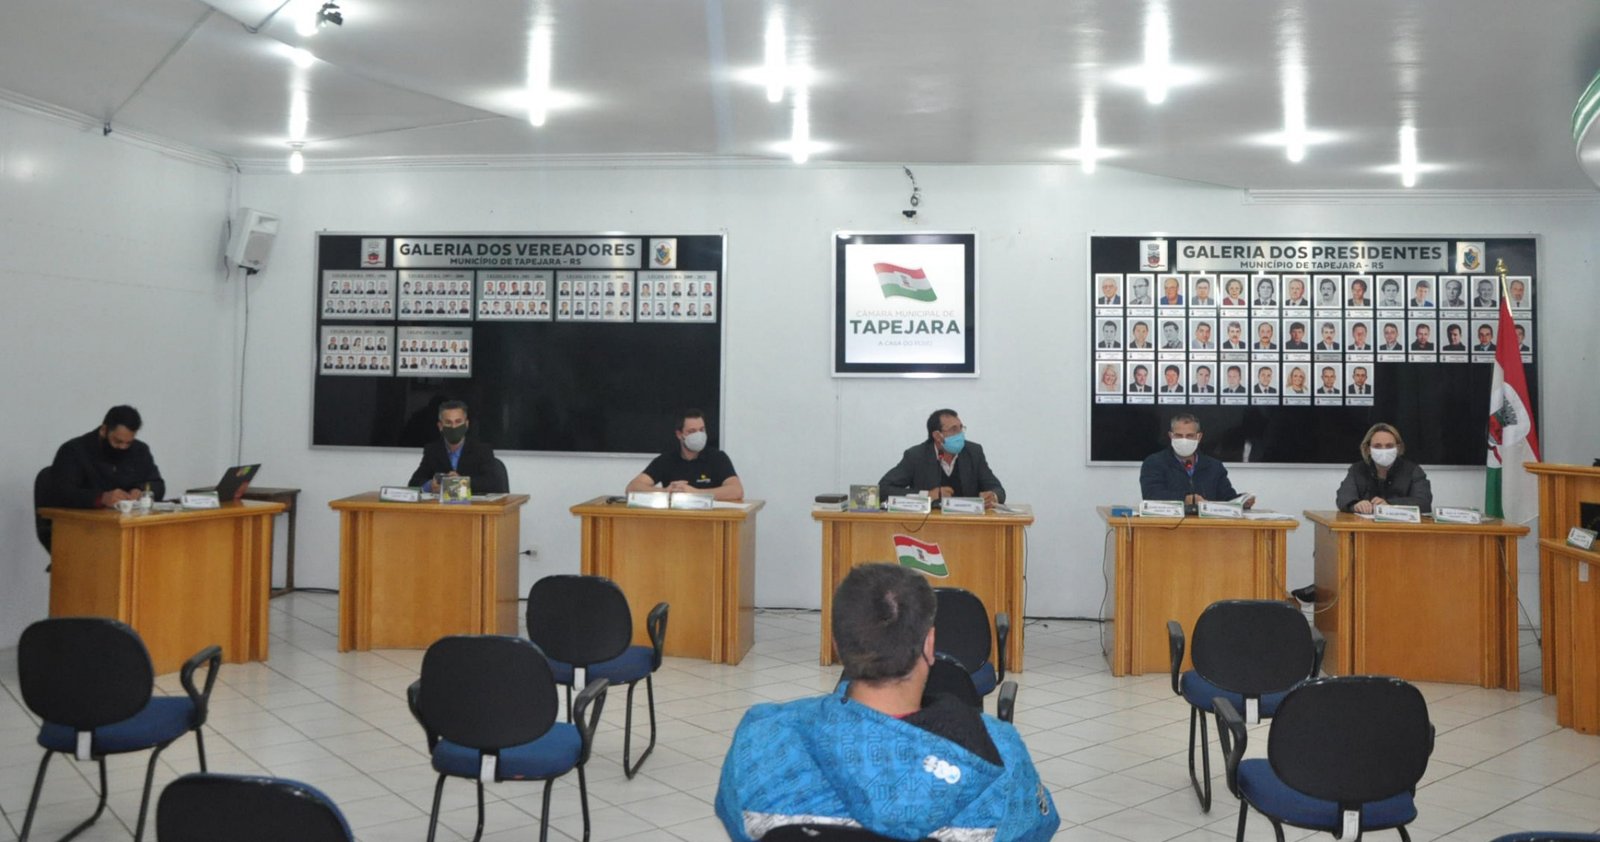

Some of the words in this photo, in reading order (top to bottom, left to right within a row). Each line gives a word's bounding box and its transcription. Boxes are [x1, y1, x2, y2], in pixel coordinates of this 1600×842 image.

[399, 243, 473, 256] GALERIA
[477, 243, 511, 256] DOS
[516, 243, 635, 256] VEREADORES
[1183, 245, 1265, 258] GALERIA
[1270, 246, 1308, 259] DOS
[1312, 246, 1442, 259] PRESIDENTES
[450, 256, 498, 265] MUNICÍPIO
[1240, 260, 1293, 269] MUNICÍPIO
[849, 319, 961, 334] TAPEJARA
